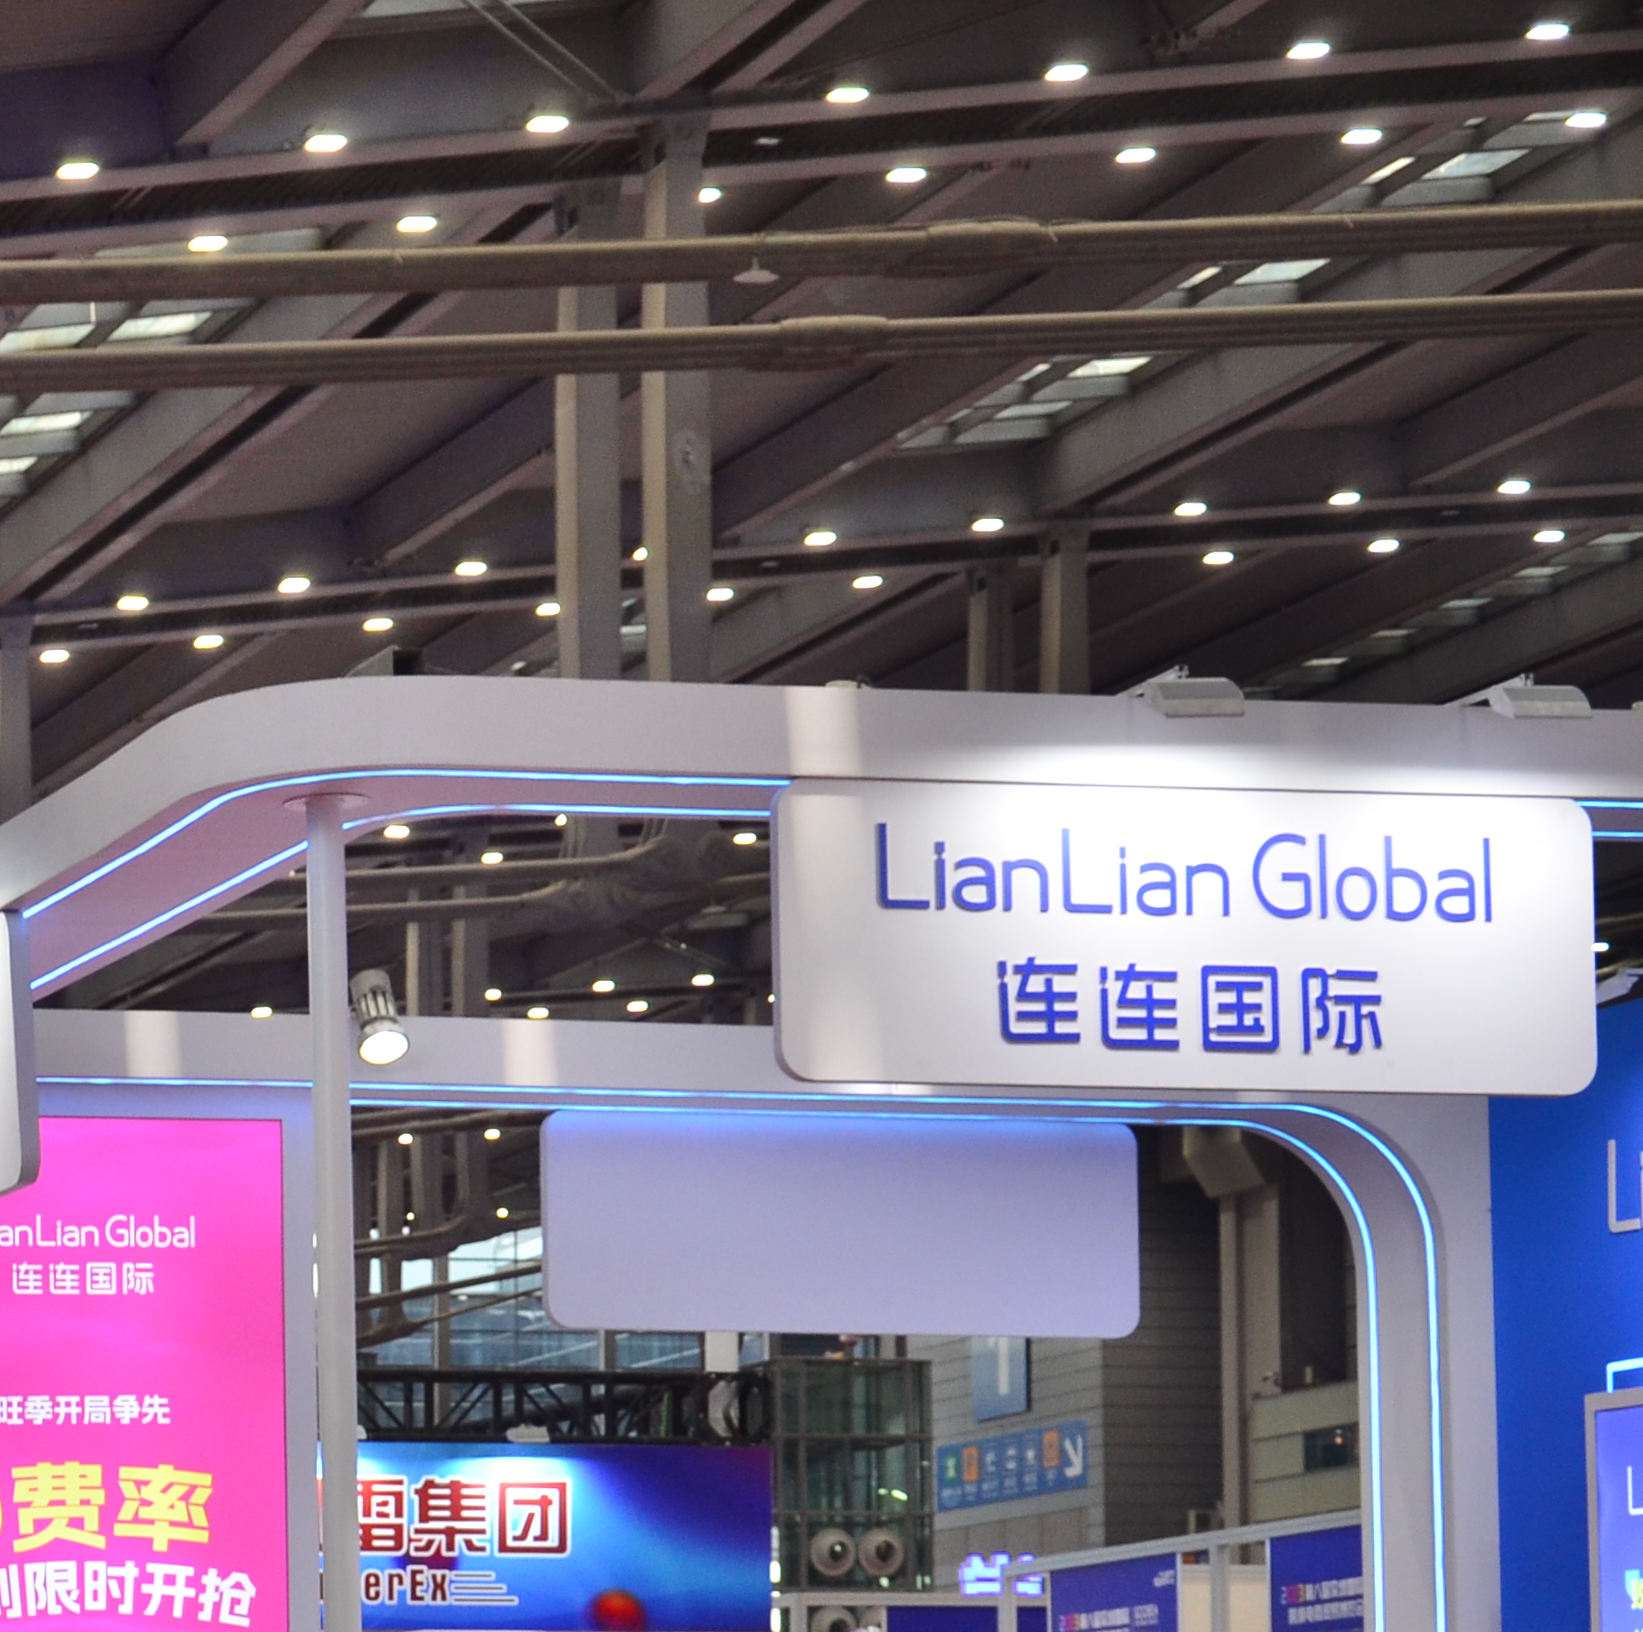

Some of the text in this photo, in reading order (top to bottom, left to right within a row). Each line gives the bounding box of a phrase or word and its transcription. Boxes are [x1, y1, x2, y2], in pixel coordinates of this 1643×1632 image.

[875, 822, 1494, 923] LianLian Global
[997, 956, 1384, 1055] 连连国际
[105, 1215, 195, 1248] Global
[12, 1261, 155, 1295] 连连国际
[357, 1475, 572, 1557] 雷集团
